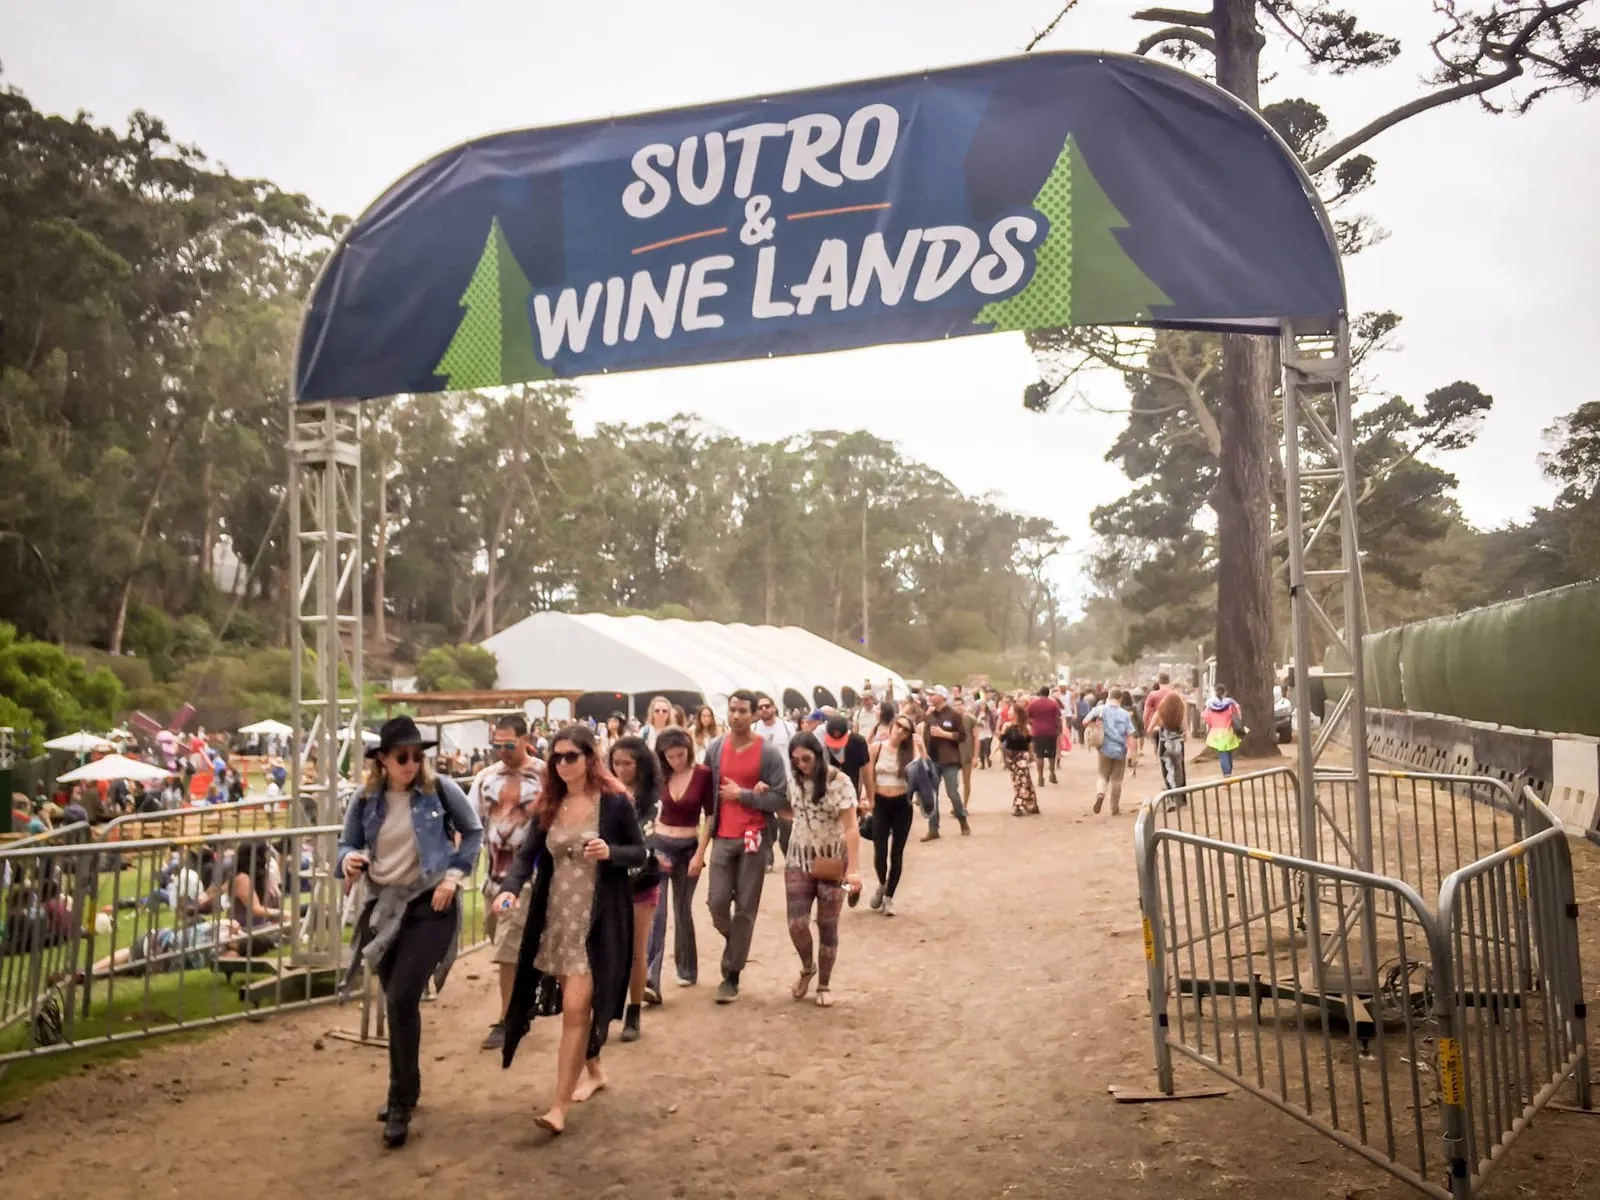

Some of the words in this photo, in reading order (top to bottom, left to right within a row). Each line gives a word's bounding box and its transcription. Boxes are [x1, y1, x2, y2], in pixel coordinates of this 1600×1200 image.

[622, 104, 900, 219] SUTRO
[739, 194, 777, 246] &
[533, 255, 735, 361] WINE
[752, 215, 1038, 319] LANDS
